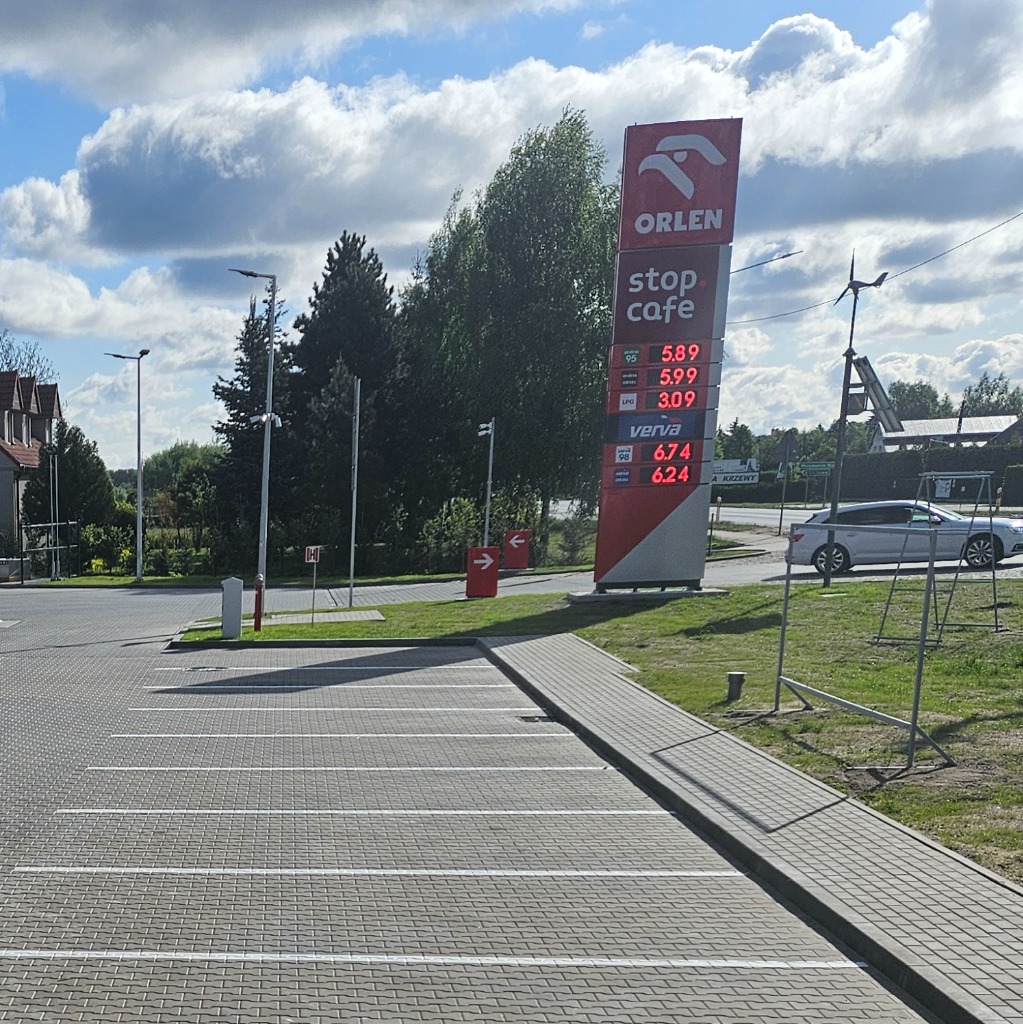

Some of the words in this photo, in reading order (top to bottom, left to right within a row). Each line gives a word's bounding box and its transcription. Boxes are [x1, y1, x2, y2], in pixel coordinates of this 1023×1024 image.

[634, 208, 723, 235] ORLEN
[626, 295, 696, 324] cafe
[625, 354, 637, 363] 95
[661, 343, 700, 362] 5.89
[659, 367, 698, 386] 5.99
[657, 390, 696, 409] 3.09
[629, 423, 682, 438] verva
[618, 453, 630, 461] 98
[653, 442, 691, 461] 6.74
[651, 465, 689, 483] 6.24
[722, 474, 757, 482] KRZEWY
